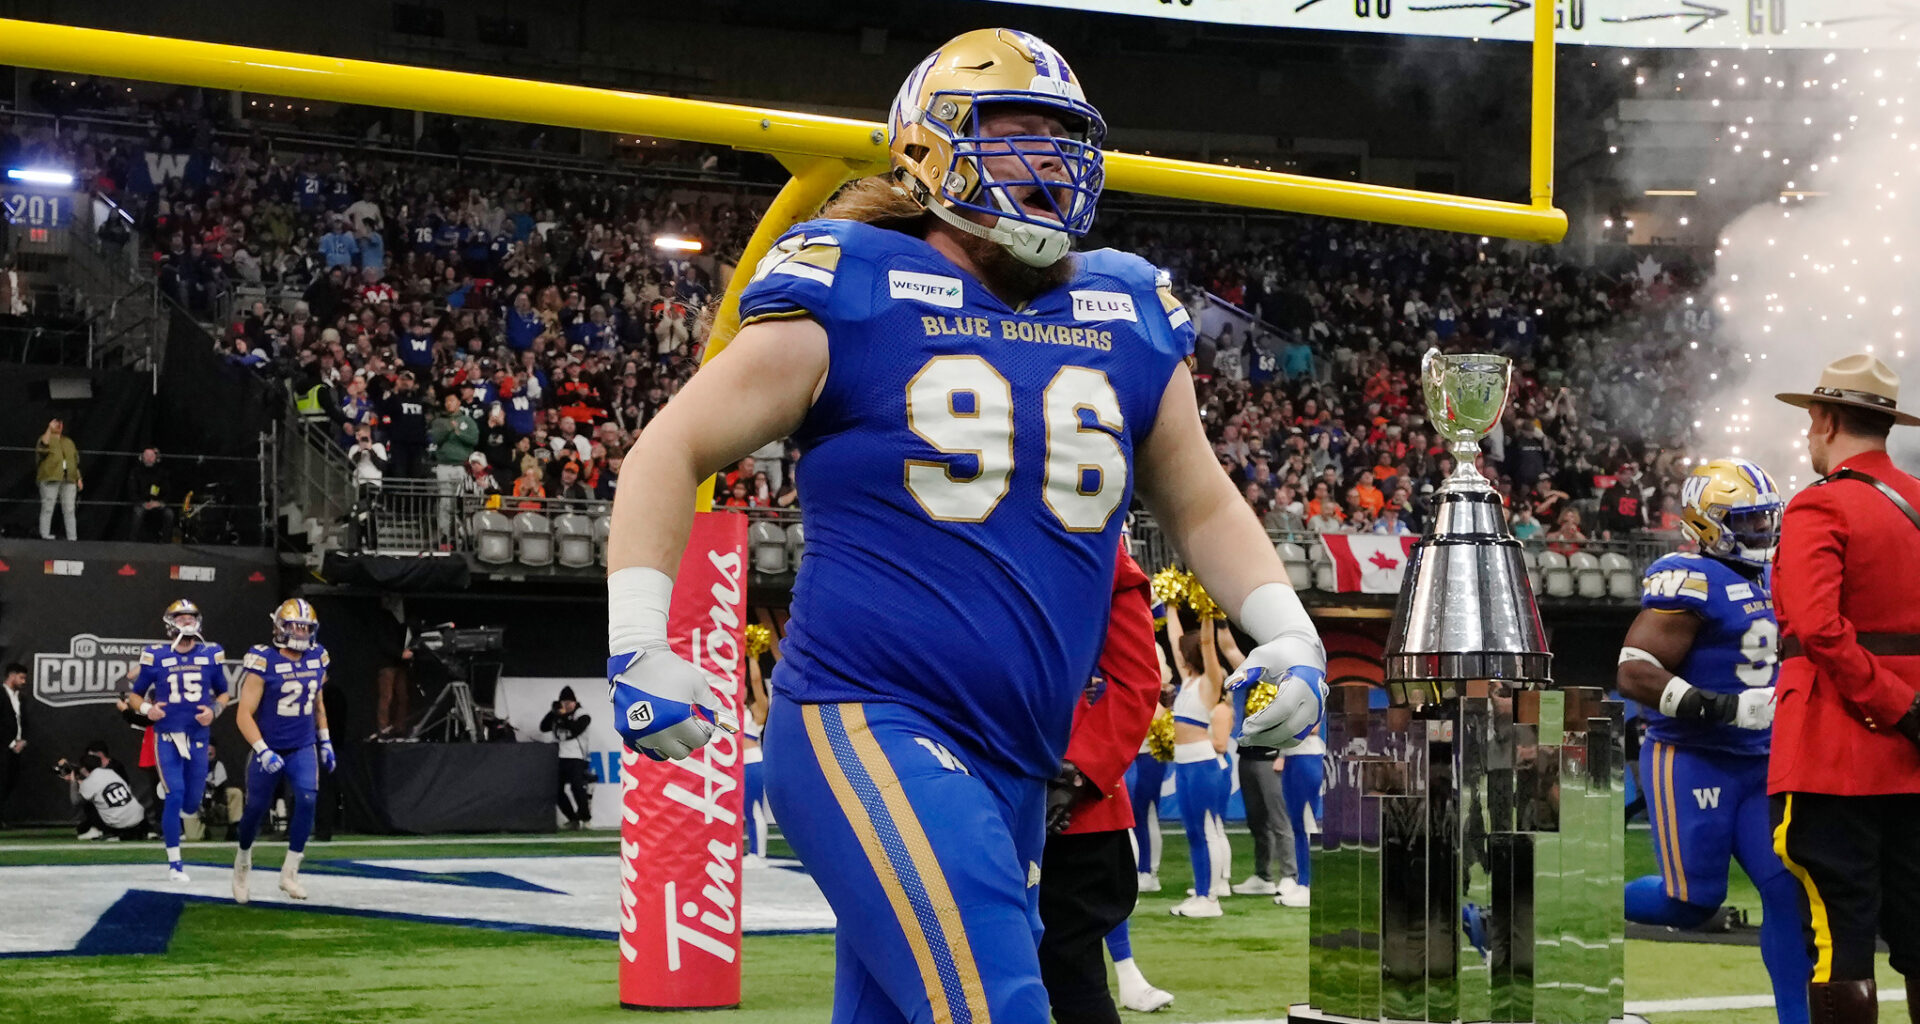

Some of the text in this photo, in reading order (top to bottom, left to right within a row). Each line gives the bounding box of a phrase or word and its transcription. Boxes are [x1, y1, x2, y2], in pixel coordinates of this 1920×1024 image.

[145, 153, 190, 184] W
[12, 195, 58, 226] 201
[892, 280, 945, 296] WESTJET
[1075, 298, 1132, 313] TELUS
[921, 316, 1112, 351] BLUE BOMBERS
[905, 354, 1127, 533] 96
[1736, 618, 1778, 687] 9
[39, 659, 140, 694] COUP
[166, 672, 202, 703] 15
[277, 680, 318, 716] 21
[662, 550, 742, 971] Tim Hotons
[1692, 787, 1721, 810] W
